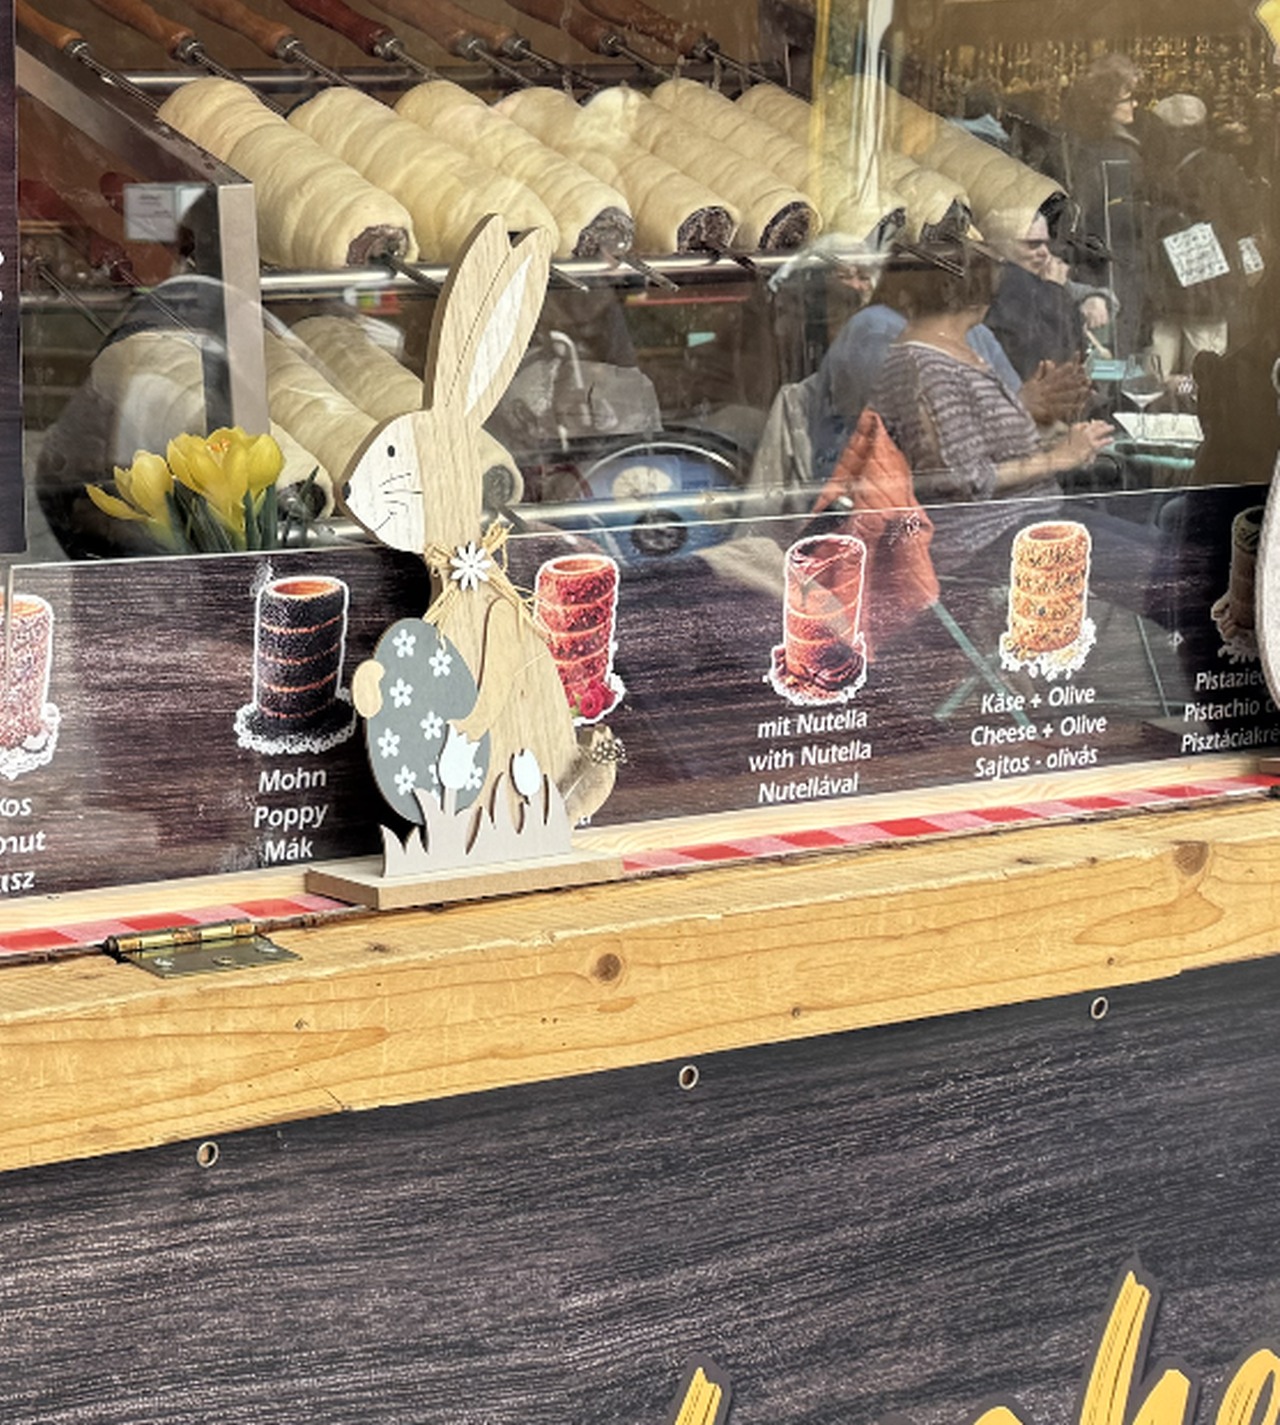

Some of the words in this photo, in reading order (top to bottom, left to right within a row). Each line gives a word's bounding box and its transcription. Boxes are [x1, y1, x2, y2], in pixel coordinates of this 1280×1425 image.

[981, 689, 1025, 715] Käse
[1030, 693, 1043, 709] +
[1049, 683, 1095, 707] Olive
[1183, 697, 1260, 723] Pistachio
[756, 714, 793, 739] mit
[796, 708, 868, 736] Nutella
[970, 721, 1038, 749] Cheese
[1041, 724, 1055, 740] +
[1060, 713, 1107, 738] Olive
[748, 746, 796, 773] with
[800, 739, 872, 767] Nutella
[974, 754, 1031, 783] Sajtos
[1046, 744, 1099, 769] olivás
[257, 766, 327, 794] Mohn
[757, 773, 858, 805] Nutellával
[253, 800, 328, 835] Poppy
[264, 835, 314, 864] Mák
